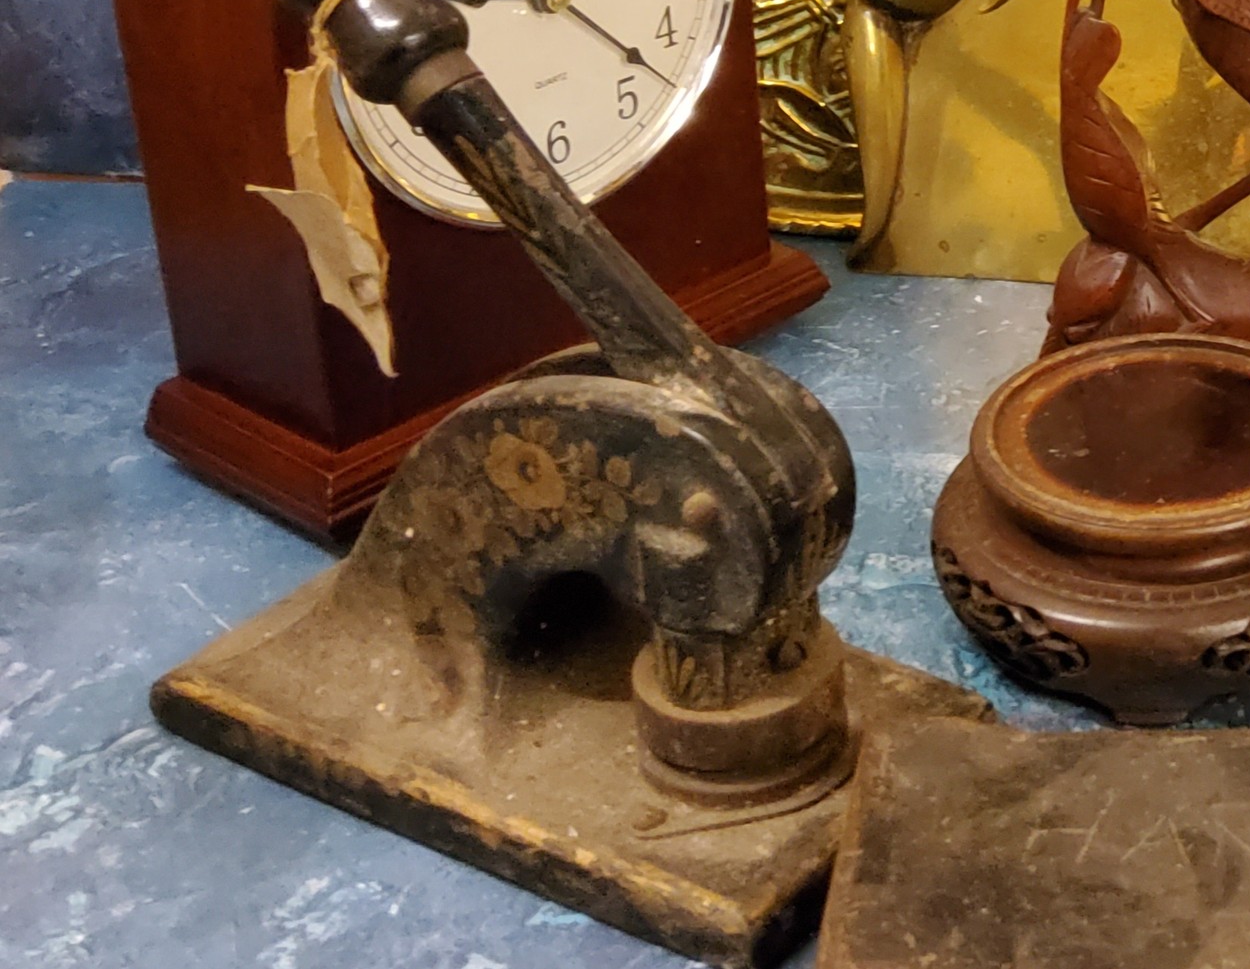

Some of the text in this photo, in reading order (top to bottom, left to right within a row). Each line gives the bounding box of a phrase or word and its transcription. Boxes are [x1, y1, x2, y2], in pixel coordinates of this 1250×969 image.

[655, 5, 679, 49] 4
[616, 75, 639, 119] 5
[547, 120, 570, 164] 6
